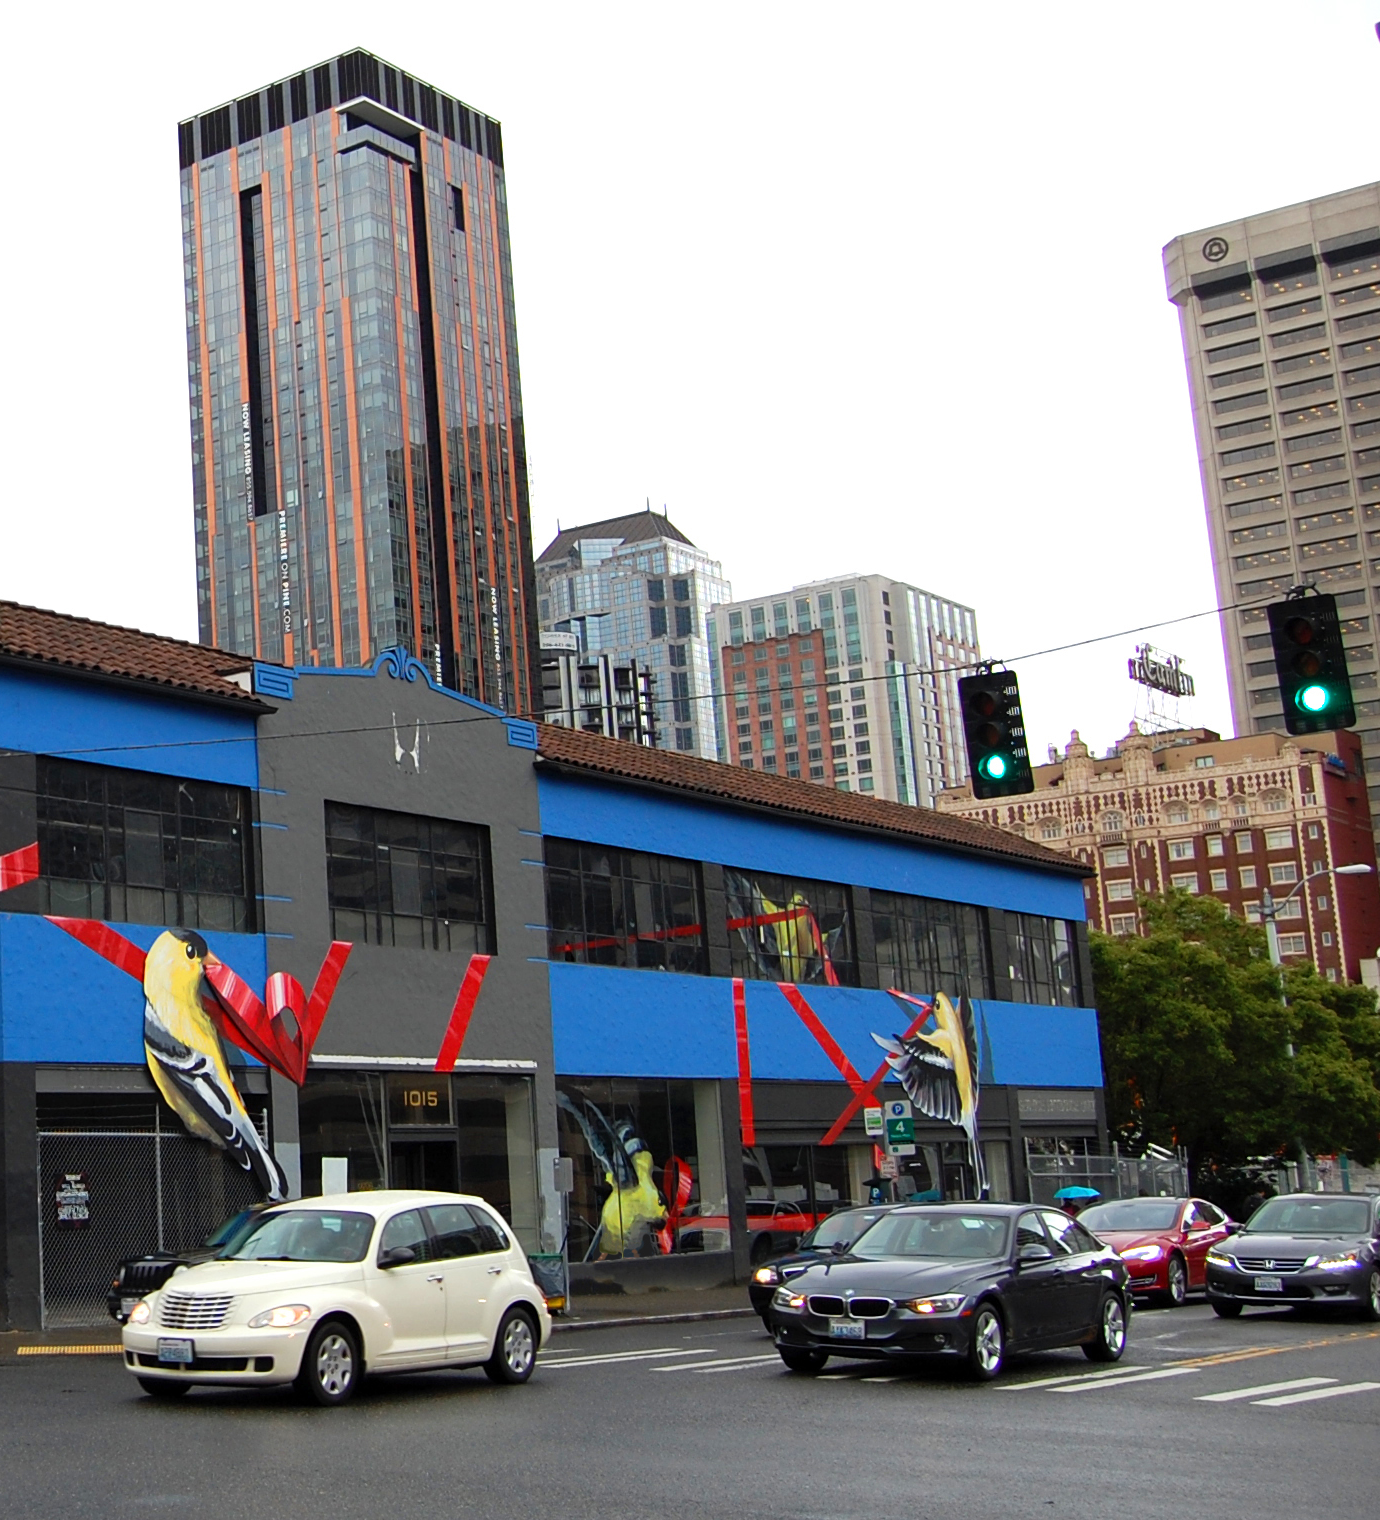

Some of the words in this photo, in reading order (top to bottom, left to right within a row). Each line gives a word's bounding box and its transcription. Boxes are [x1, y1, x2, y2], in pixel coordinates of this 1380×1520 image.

[242, 403, 250, 428] NOW
[244, 432, 252, 474] LEASING
[404, 1090, 438, 1106] 1015
[895, 1120, 905, 1133] 4
